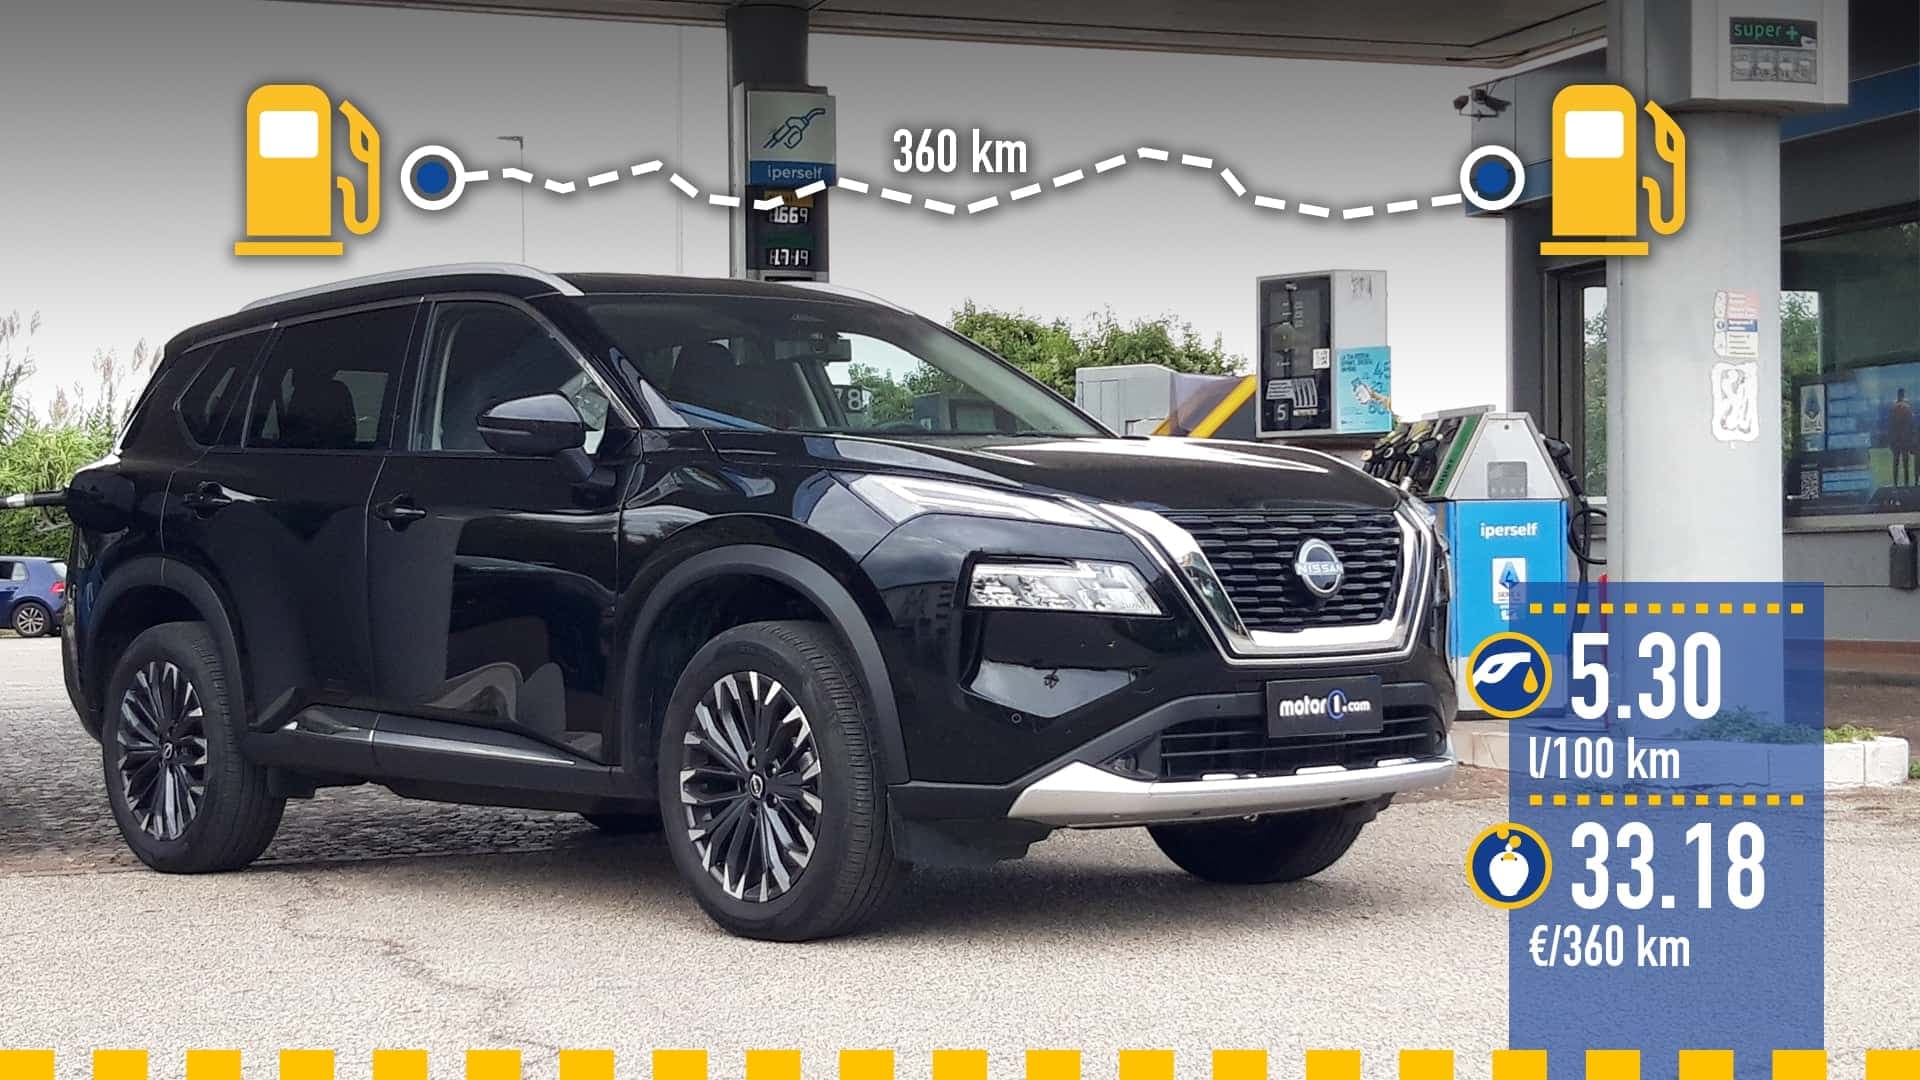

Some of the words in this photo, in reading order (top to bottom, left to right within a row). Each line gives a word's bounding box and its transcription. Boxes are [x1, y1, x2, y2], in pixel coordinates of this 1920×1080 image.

[767, 165, 823, 181] iperself
[1277, 404, 1287, 421] 5
[1480, 522, 1538, 539] iperself
[1297, 561, 1344, 575] NISSAN
[1279, 691, 1371, 719] motor1.com
